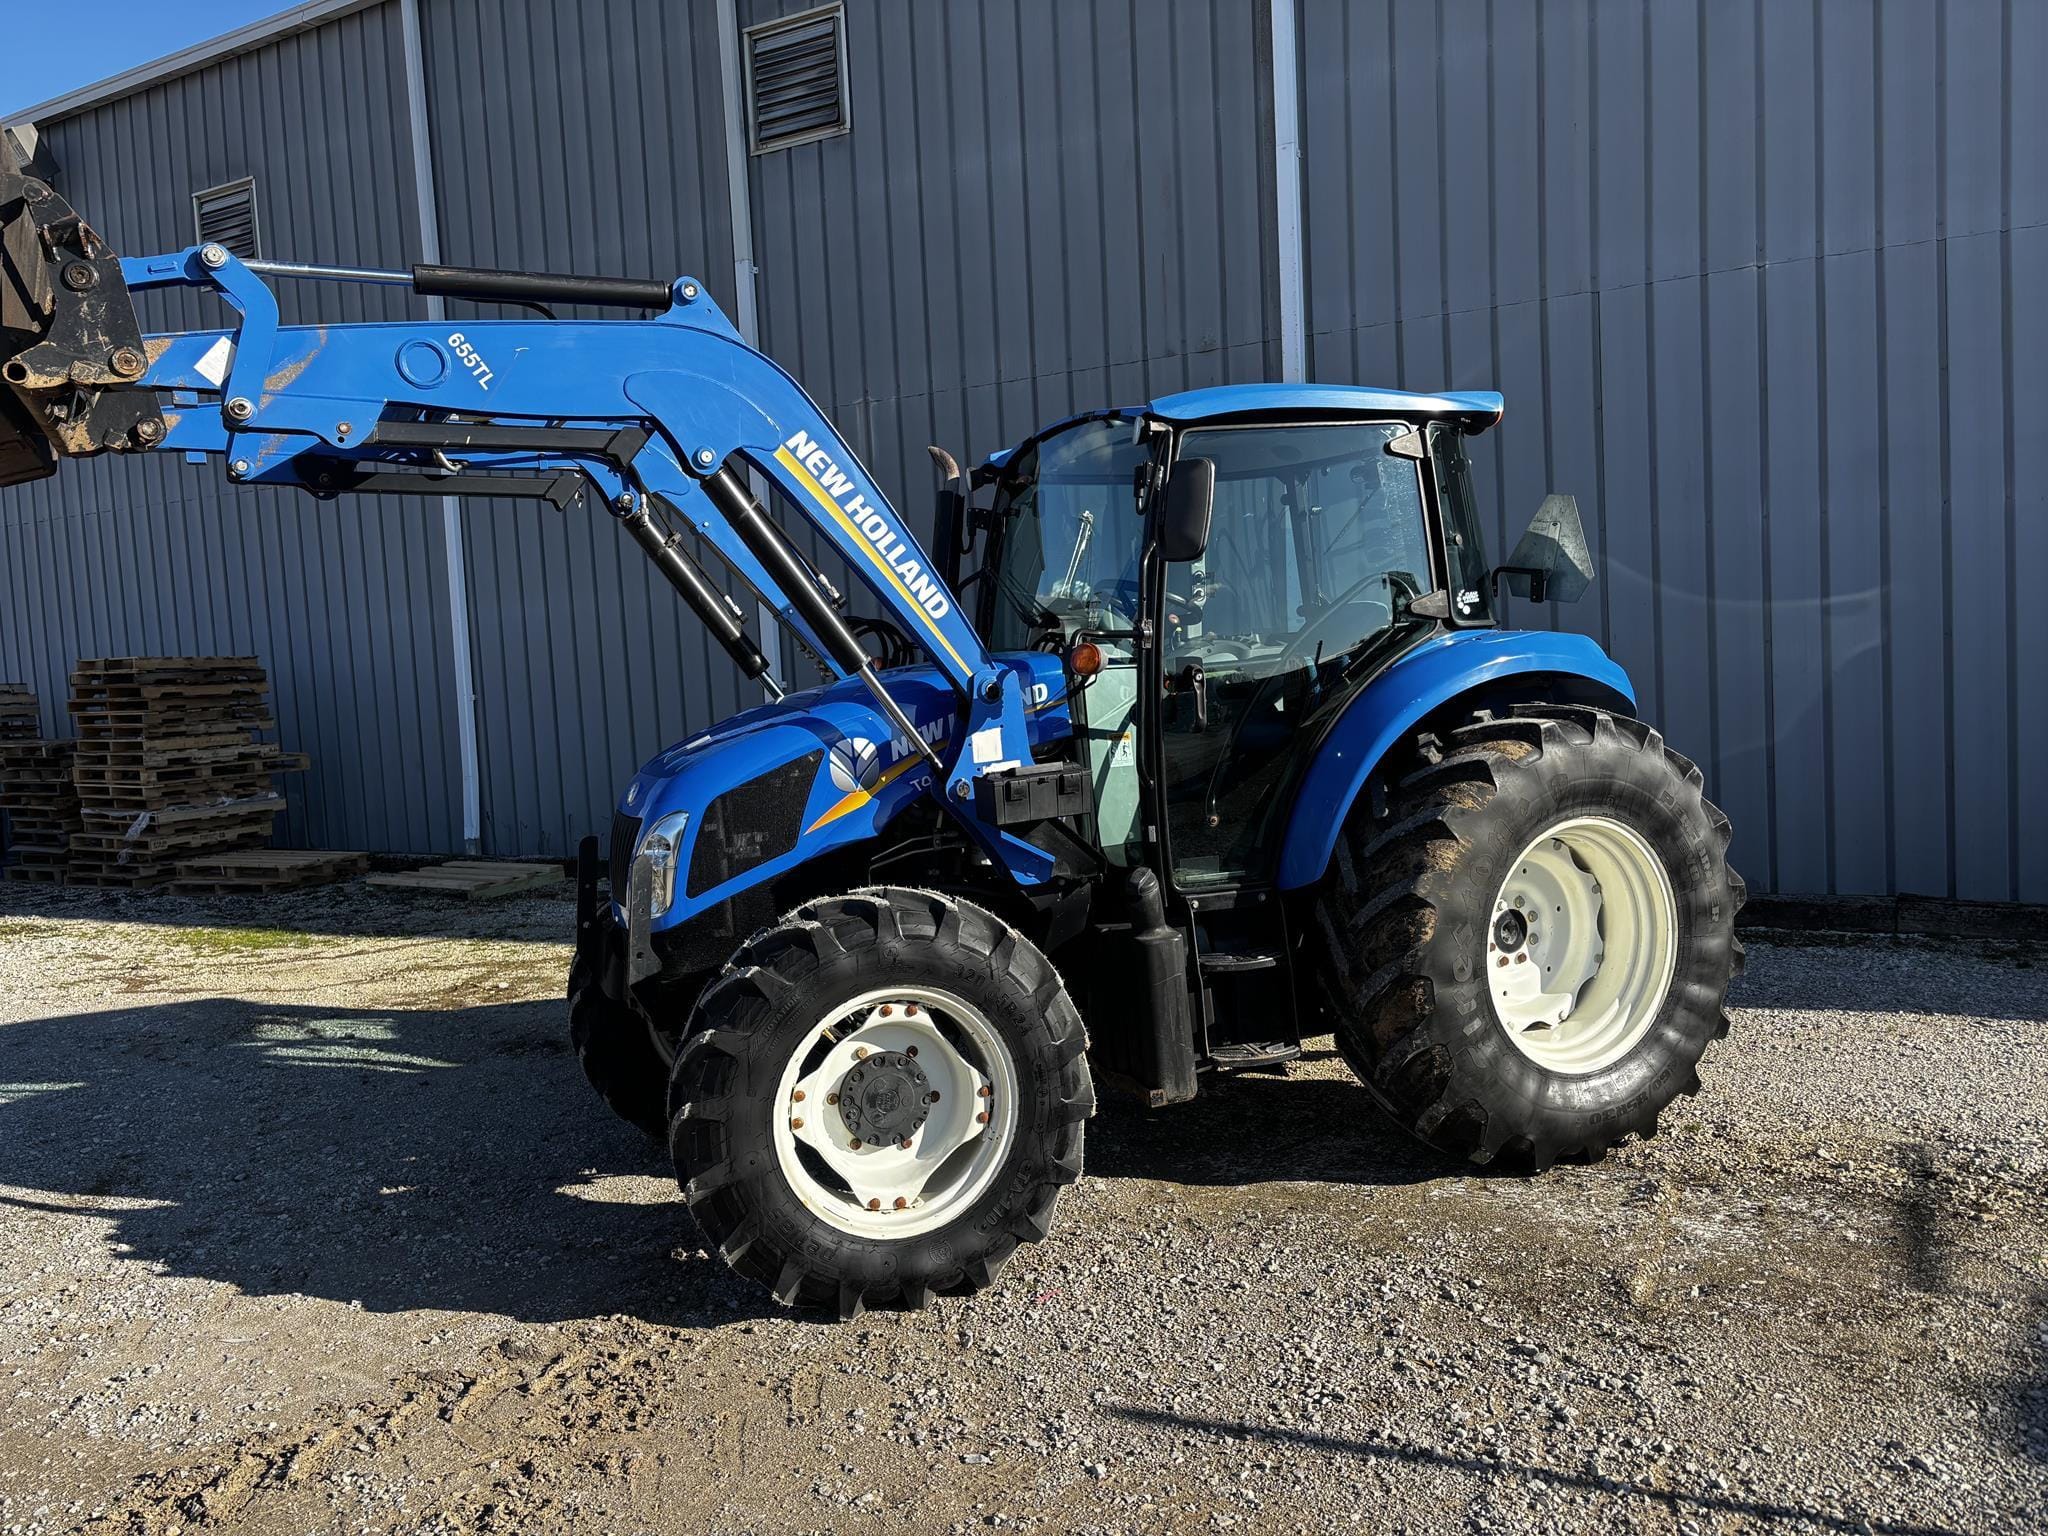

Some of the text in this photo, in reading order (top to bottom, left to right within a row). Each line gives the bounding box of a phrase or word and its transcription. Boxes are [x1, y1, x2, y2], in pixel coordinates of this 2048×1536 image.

[447, 332, 494, 391] 655TL
[785, 430, 949, 621] NEW HOLLAND
